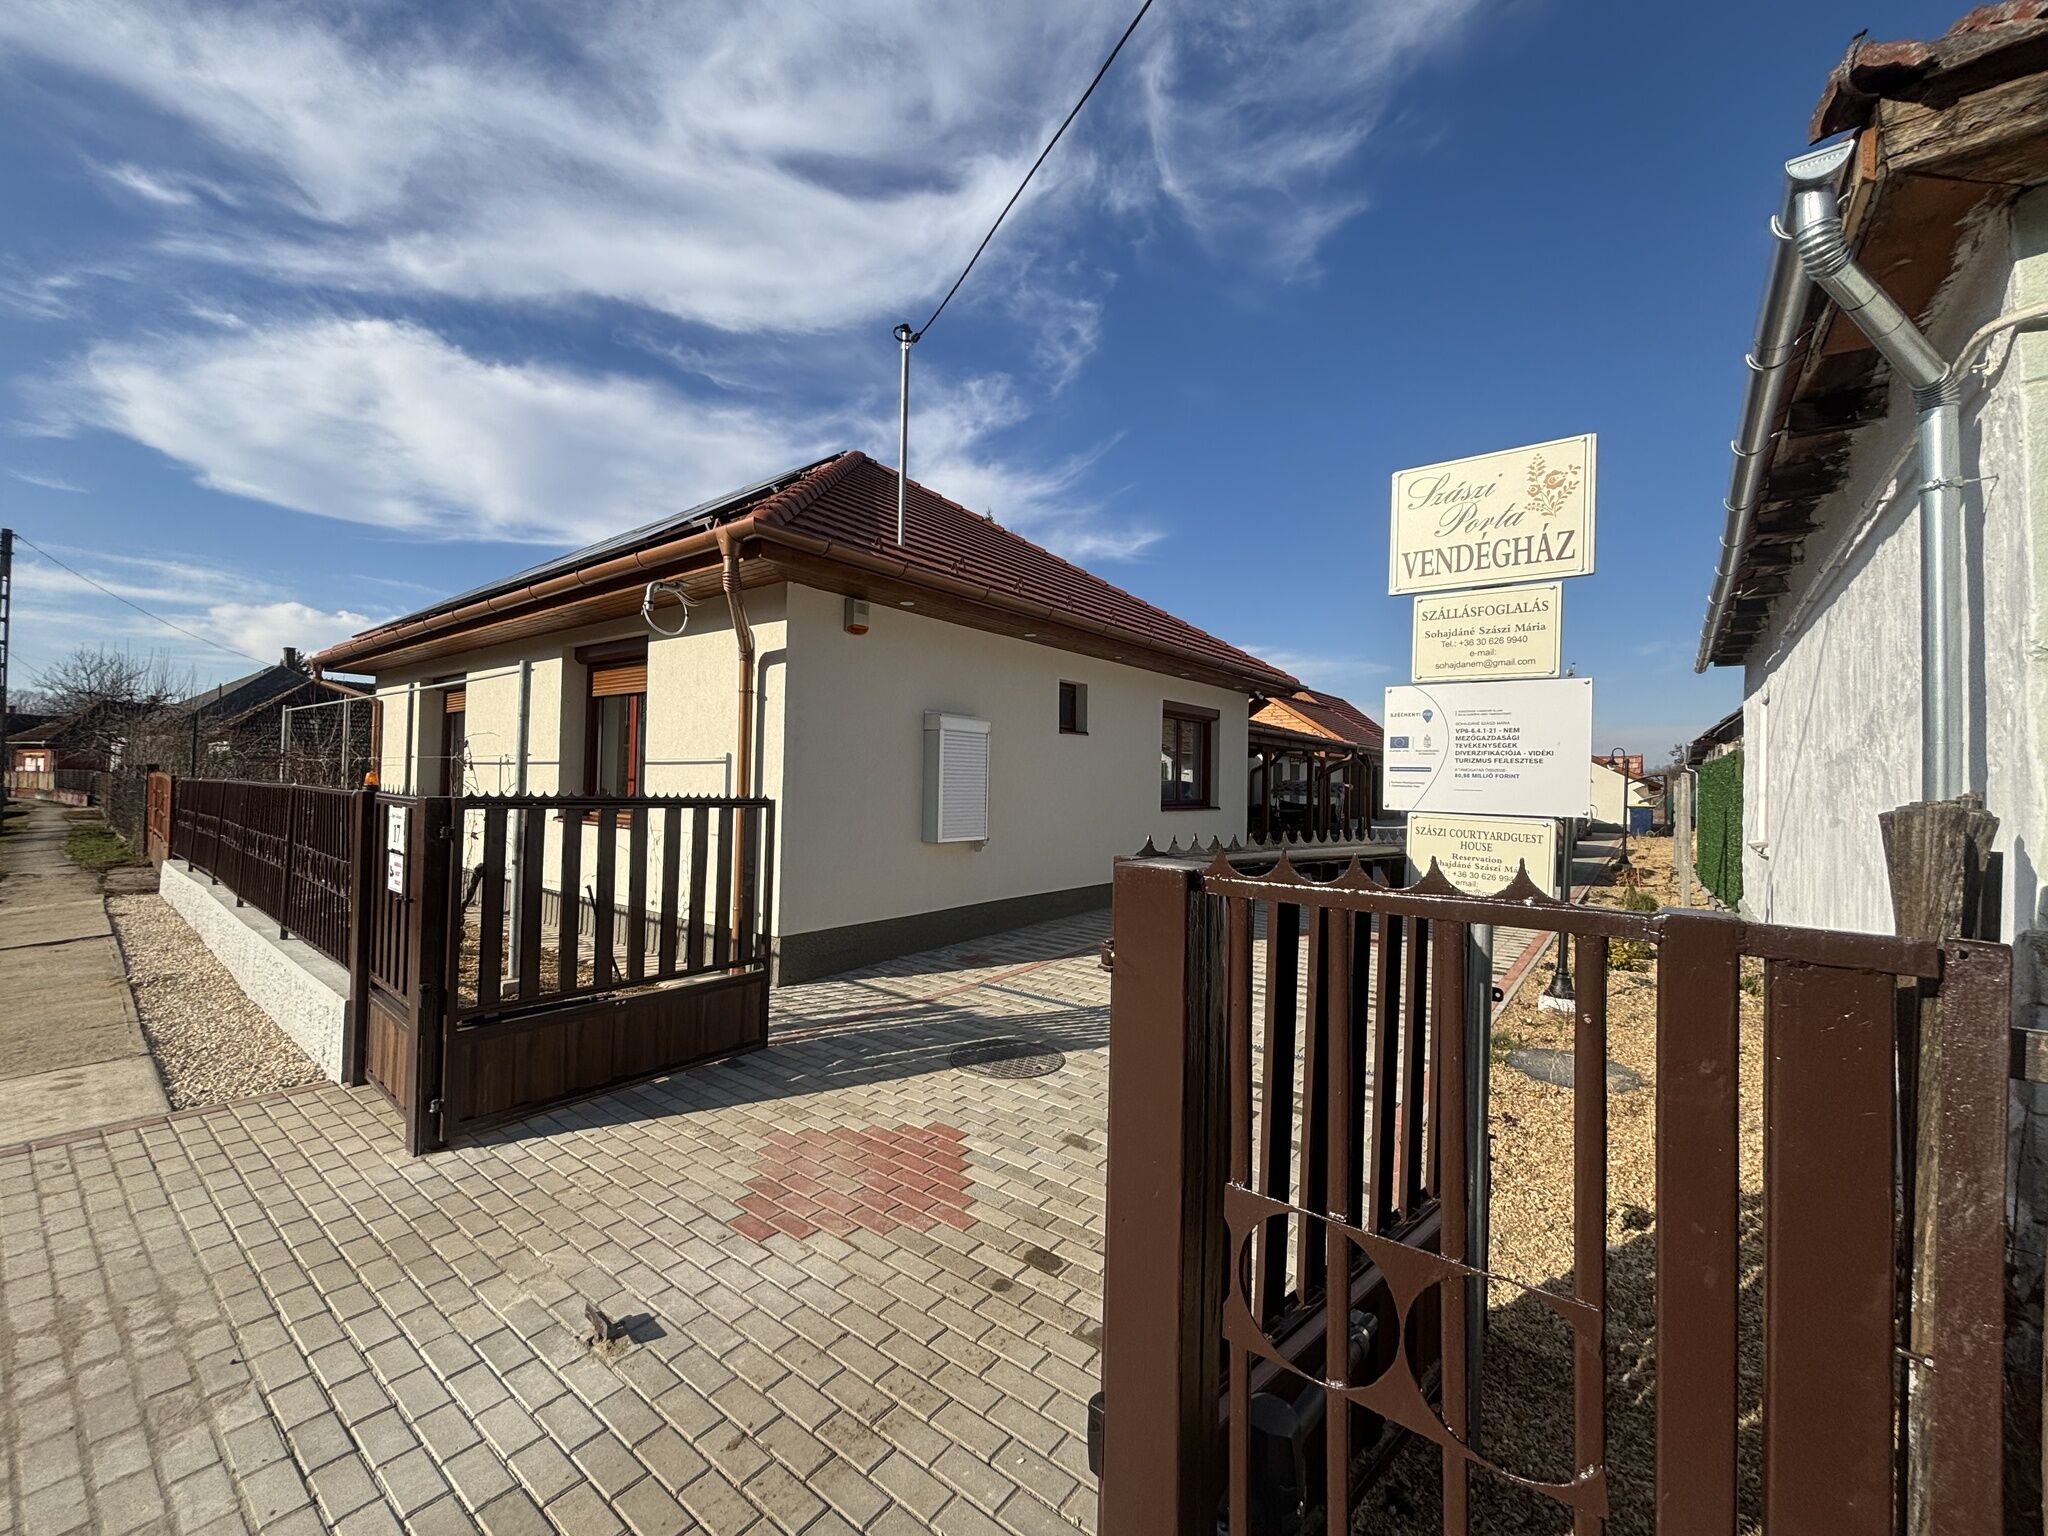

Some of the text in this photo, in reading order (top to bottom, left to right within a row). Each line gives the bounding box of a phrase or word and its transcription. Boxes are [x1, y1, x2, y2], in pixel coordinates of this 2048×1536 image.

[1407, 472, 1504, 510] Szászi
[1434, 501, 1527, 538] Porta
[1402, 523, 1576, 579] VENDÉGHÁZ
[1421, 598, 1549, 622] SZÁLLÁSFOGLALÁS
[1424, 622, 1547, 640] Sohajdáné Szászi Mária
[1476, 637, 1487, 646] 30
[1488, 636, 1505, 645] 626
[1506, 635, 1528, 644] 9940
[1415, 825, 1544, 844] SZÁSZI COURTYARDGUEST
[1460, 841, 1493, 852] HOUSE
[1452, 853, 1503, 864] Reservation
[1474, 862, 1502, 873] Szászi
[1469, 872, 1480, 880] 30
[1481, 873, 1497, 882] 626
